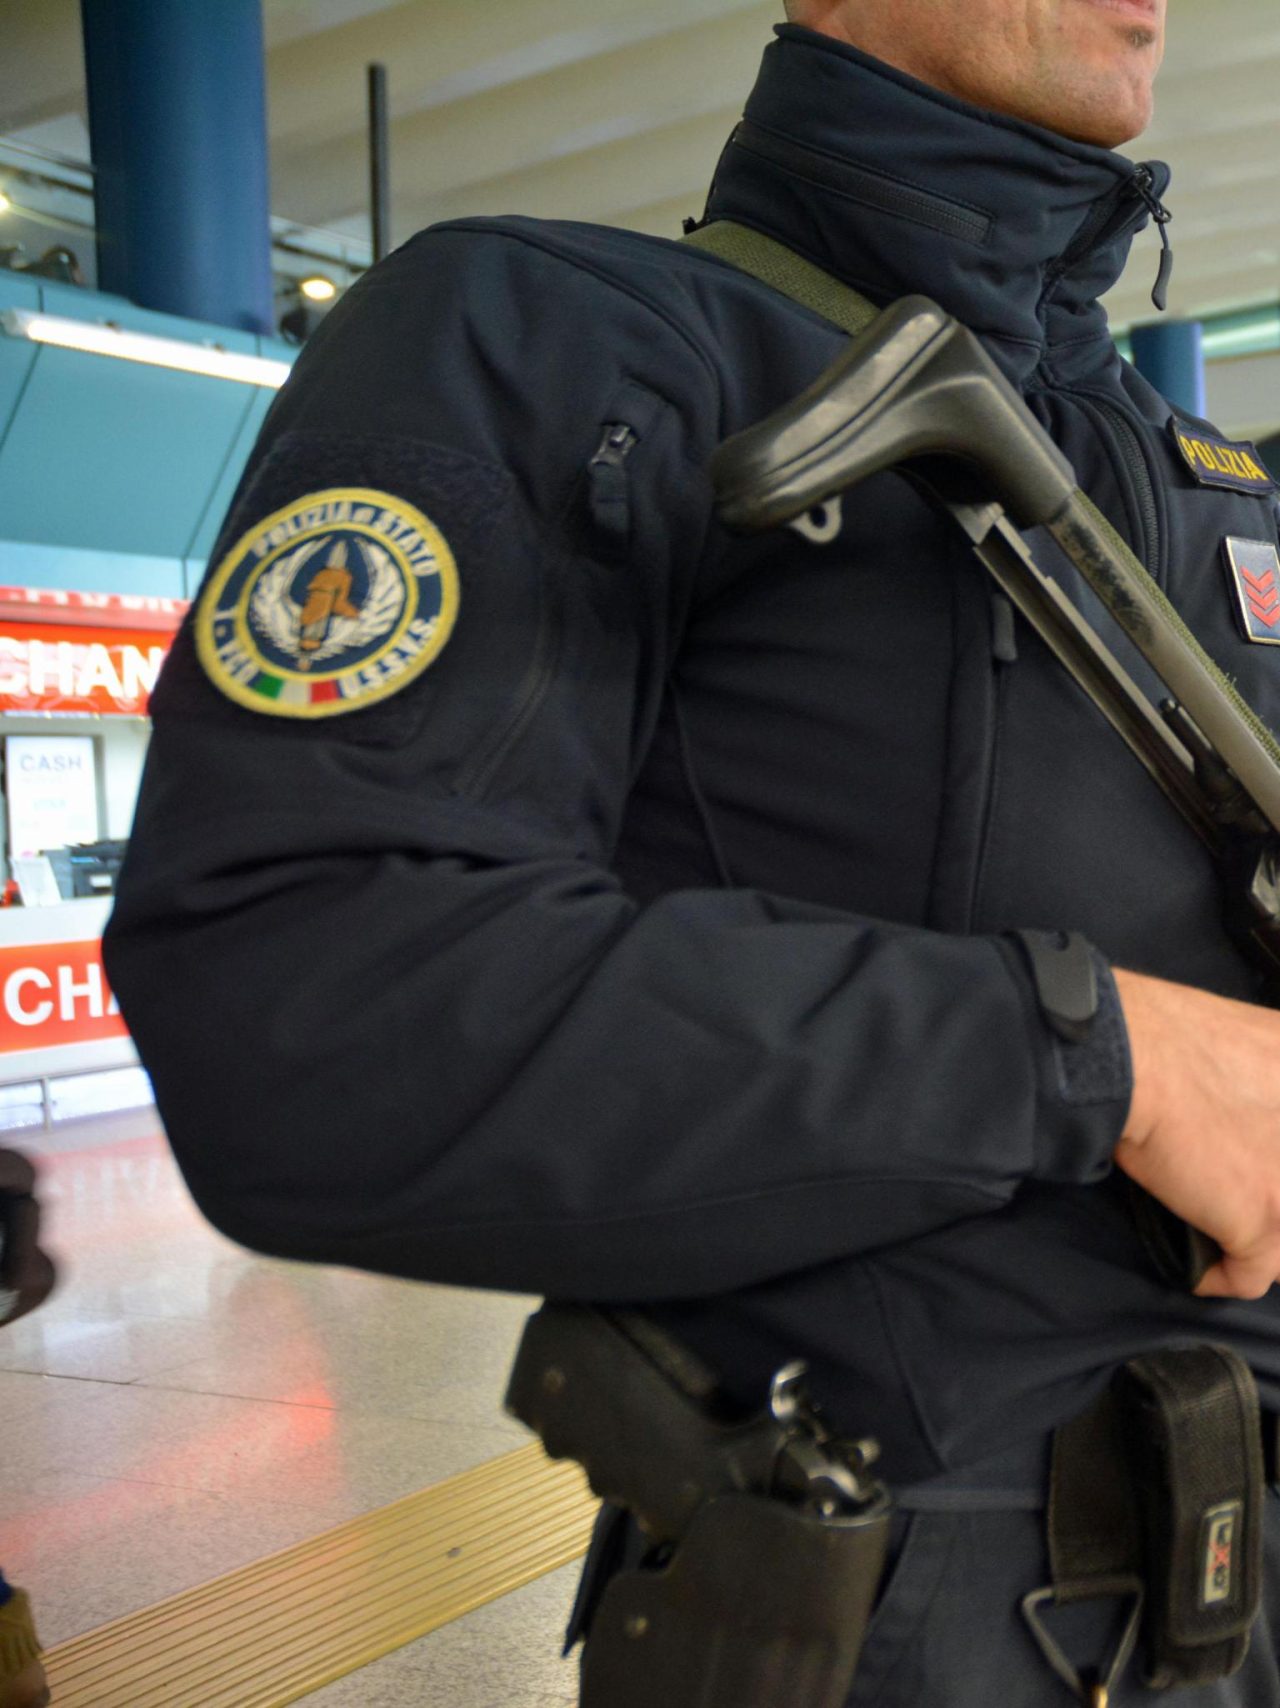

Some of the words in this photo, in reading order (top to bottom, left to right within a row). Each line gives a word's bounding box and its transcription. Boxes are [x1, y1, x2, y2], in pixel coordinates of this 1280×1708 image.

[1179, 434, 1269, 481] POLIZIA
[251, 501, 351, 558] POLIZIA
[373, 509, 440, 577] STATO
[19, 753, 83, 772] CASH
[4, 963, 120, 1026] CH
